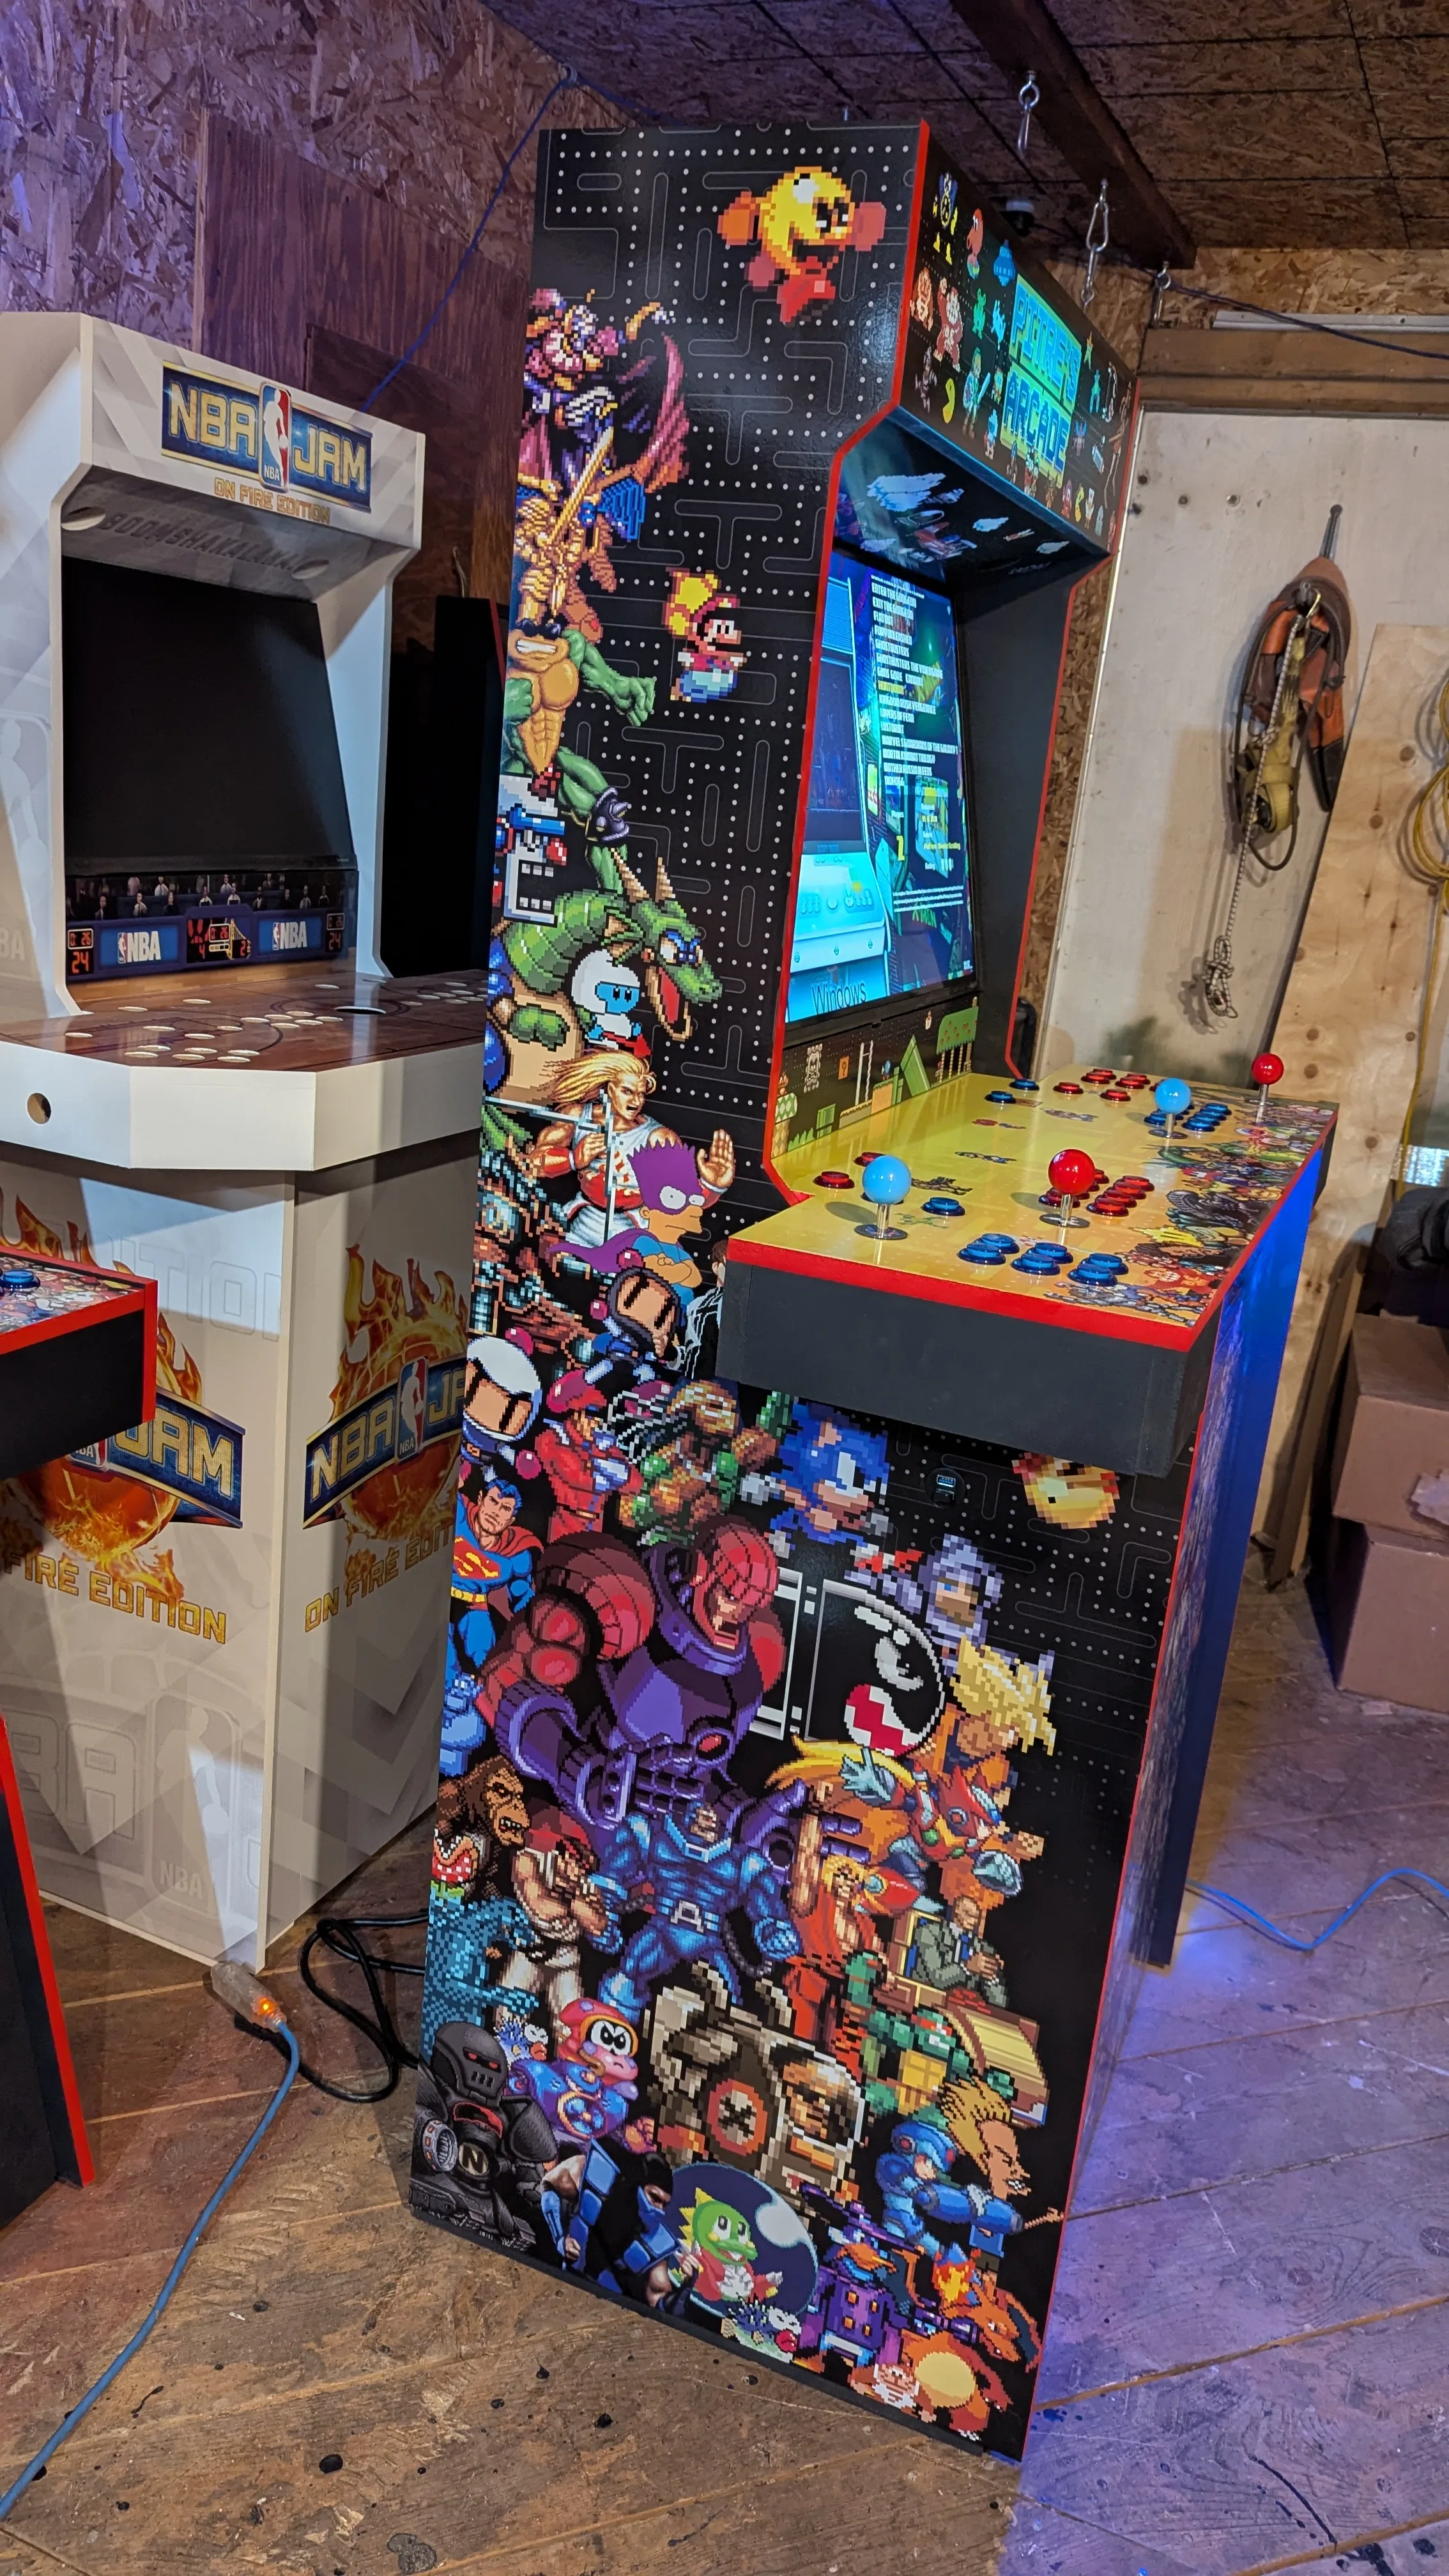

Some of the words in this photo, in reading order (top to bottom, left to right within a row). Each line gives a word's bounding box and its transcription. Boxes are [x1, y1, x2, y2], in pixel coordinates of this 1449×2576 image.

[1012, 283, 1081, 403] PITRE'S
[169, 381, 257, 457] NBA
[293, 424, 367, 491] JAM
[1004, 370, 1070, 473] ARCADE
[264, 464, 280, 482] NBA
[214, 477, 236, 500] ON
[240, 484, 273, 510] FIRE
[277, 495, 330, 525] EDITION
[127, 930, 161, 963] NBA
[280, 921, 307, 949] NBA
[72, 951, 89, 974] 24
[811, 979, 866, 1015] Windows
[310, 1397, 395, 1502] NBA
[429, 1367, 465, 1424] JA
[399, 1438, 415, 1455] NBA
[4, 1551, 80, 1597] FIRE
[89, 1570, 227, 1644] EDITION
[305, 1586, 339, 1633] ON
[345, 1549, 400, 1607] FIRE
[405, 1521, 454, 1571] EDIT
